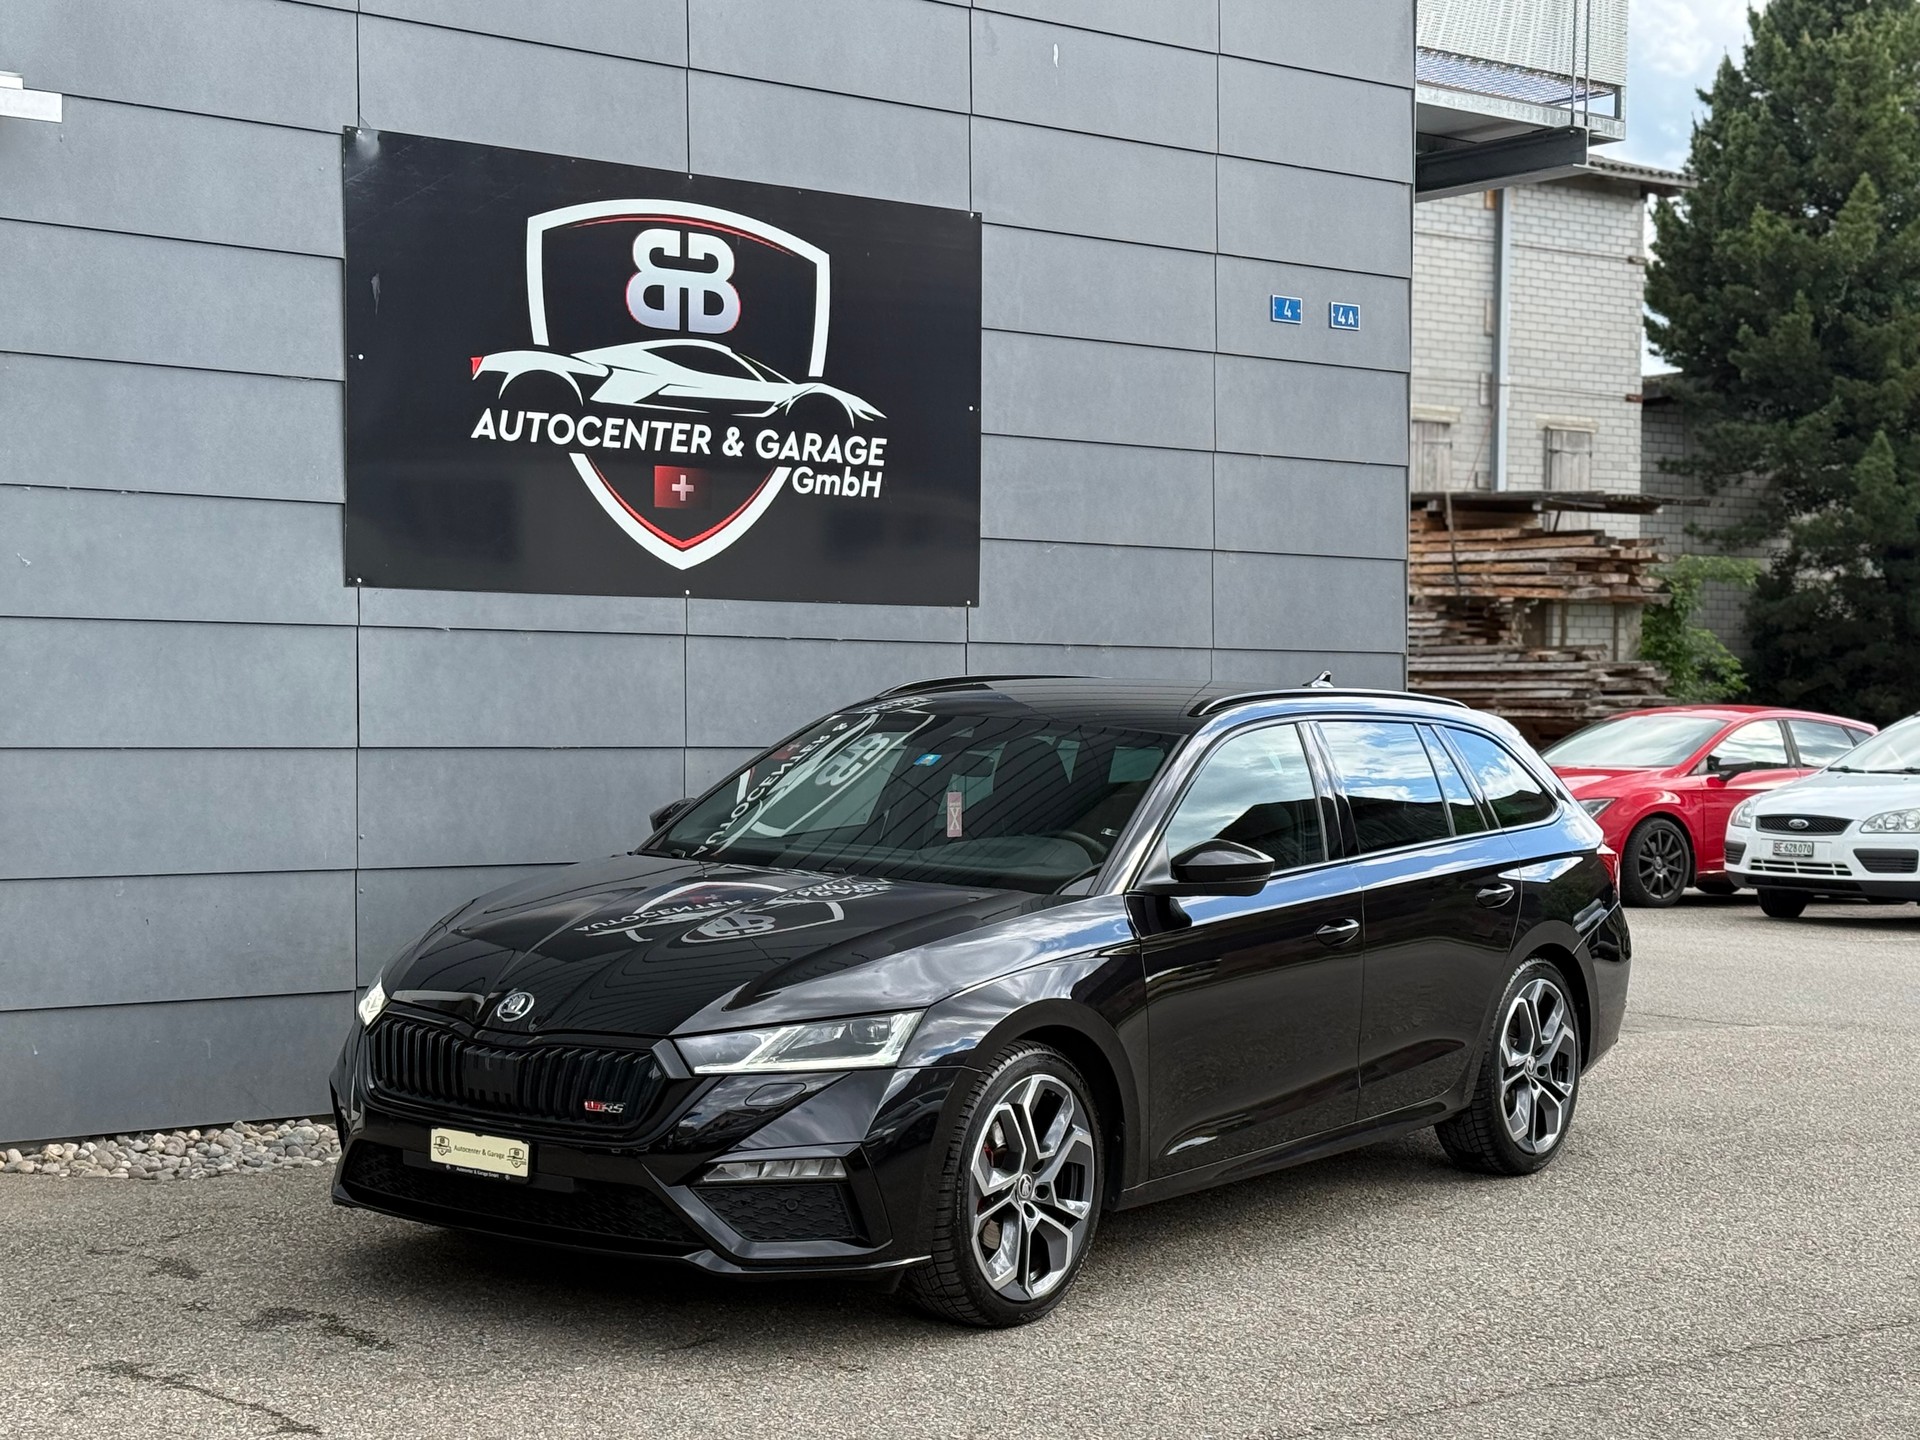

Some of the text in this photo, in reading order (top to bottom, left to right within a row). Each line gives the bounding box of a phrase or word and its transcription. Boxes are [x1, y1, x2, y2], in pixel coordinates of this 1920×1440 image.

[1283, 299, 1292, 318] 4
[1337, 306, 1355, 326] 4A
[470, 407, 888, 468] AUTOCENTER & GARAGE
[791, 466, 884, 500] GmbH
[454, 1145, 481, 1155] Autocenter
[487, 1150, 505, 1160] Garage
